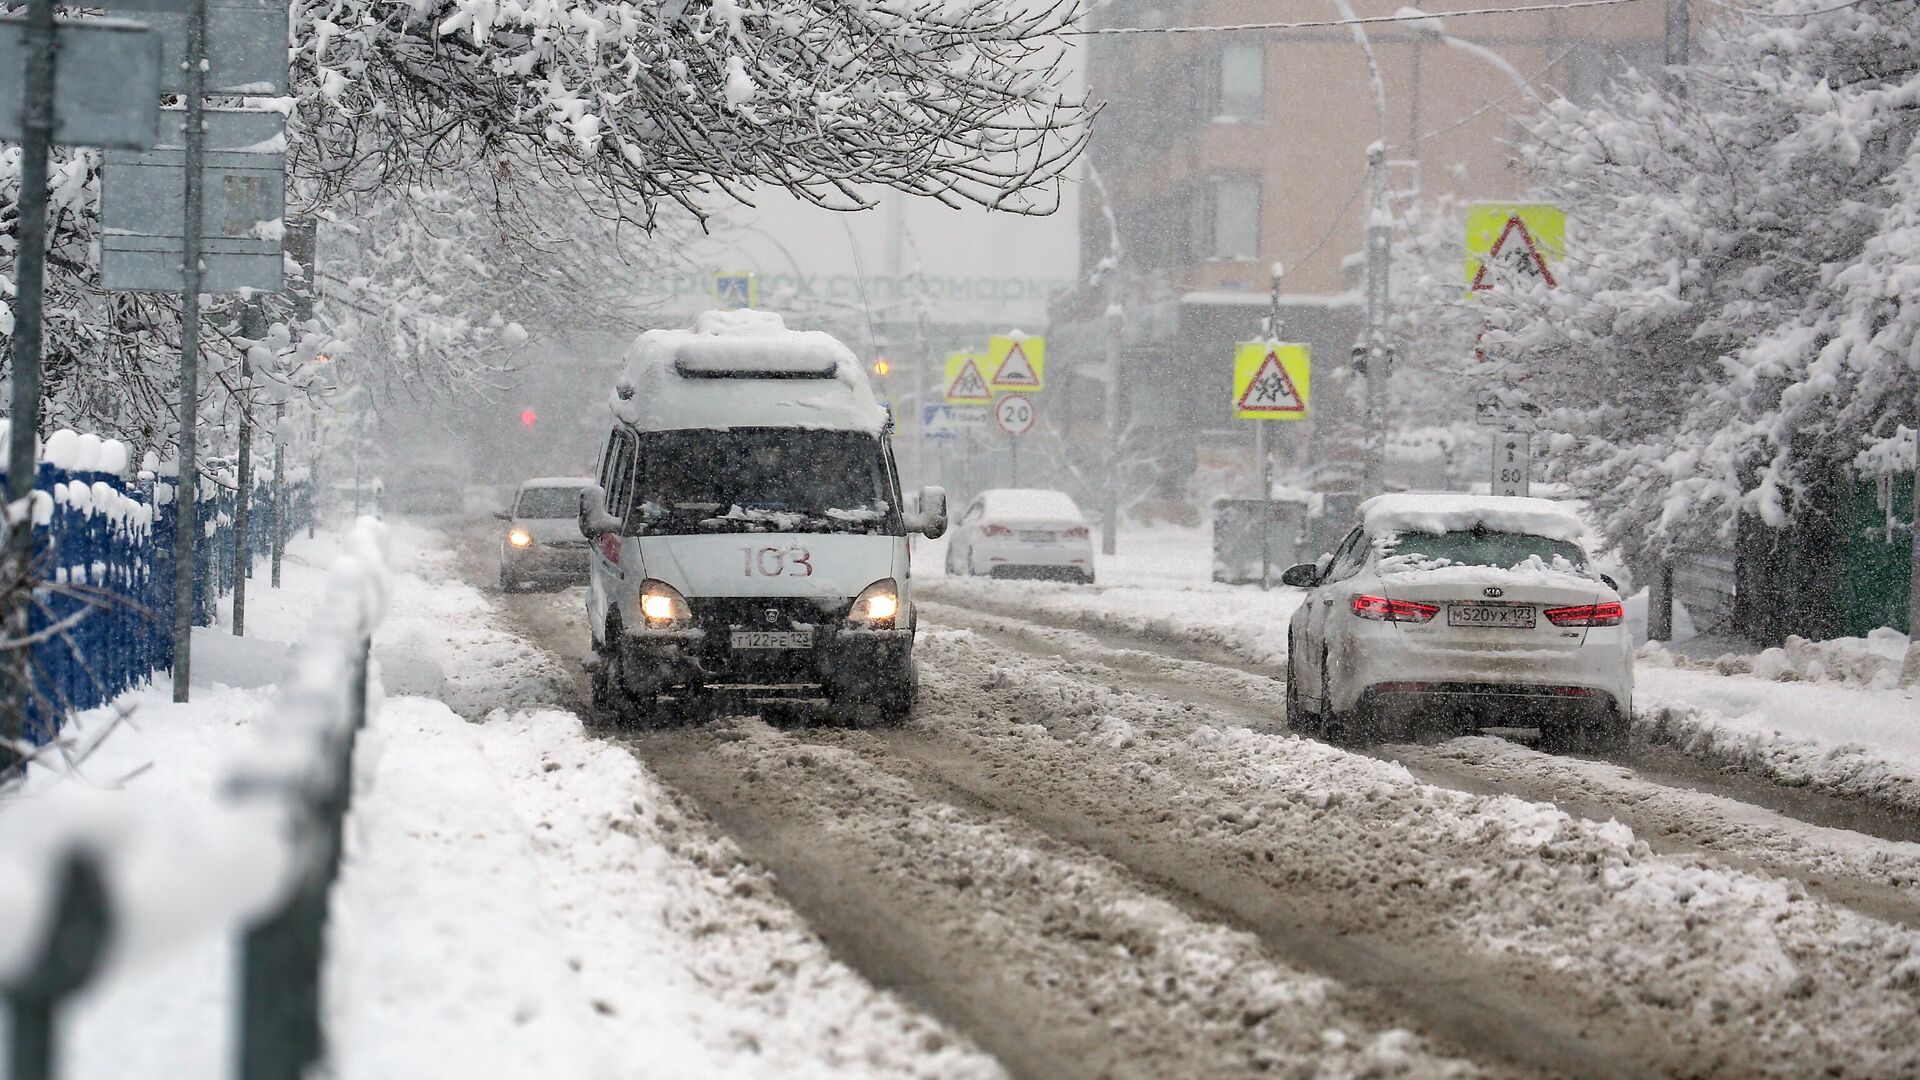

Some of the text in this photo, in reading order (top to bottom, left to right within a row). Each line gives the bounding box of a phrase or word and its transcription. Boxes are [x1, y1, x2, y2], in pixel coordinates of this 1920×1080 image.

[1004, 406, 1029, 422] 20
[1501, 468, 1520, 483] 80
[738, 547, 813, 577] 103
[1485, 587, 1501, 597] KIA
[1511, 608, 1531, 620] 123
